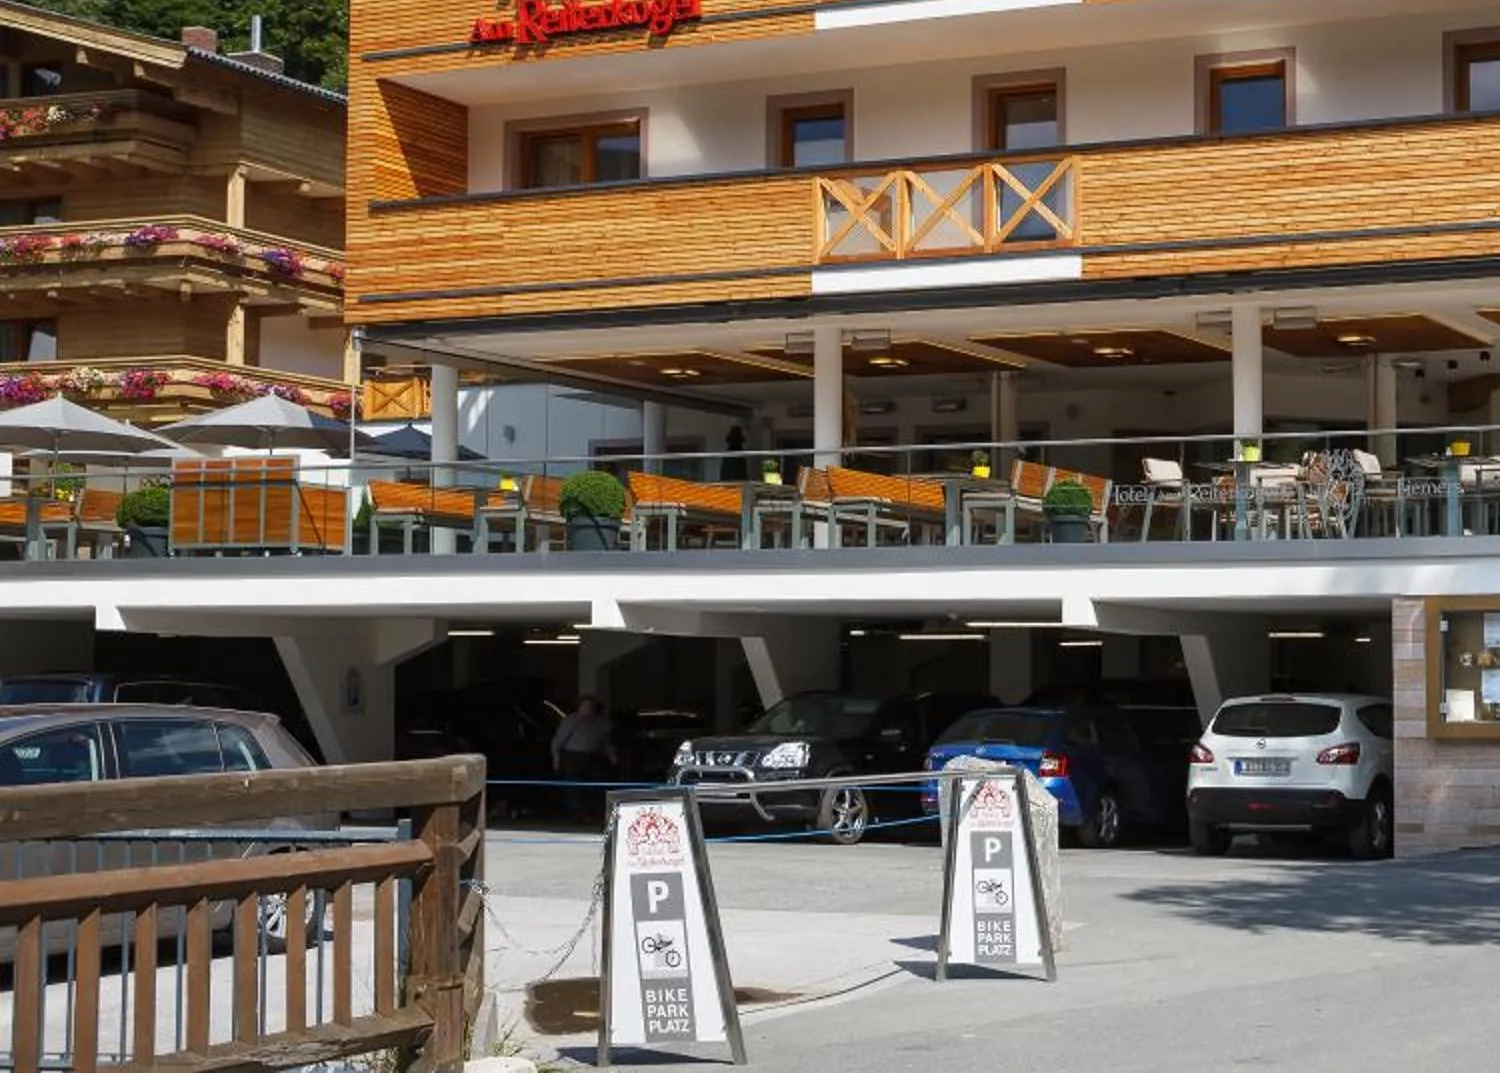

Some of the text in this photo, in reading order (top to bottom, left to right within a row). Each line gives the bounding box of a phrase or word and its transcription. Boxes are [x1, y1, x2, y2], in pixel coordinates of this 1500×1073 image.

[985, 837, 1001, 862] P
[647, 880, 669, 914] P
[977, 920, 1011, 932] BIKE
[977, 933, 1012, 944] PARK
[977, 945, 1013, 956] PLATZ
[645, 988, 688, 1002] BIKE
[647, 1004, 689, 1018] PARK
[649, 1019, 690, 1034] PLATZ
